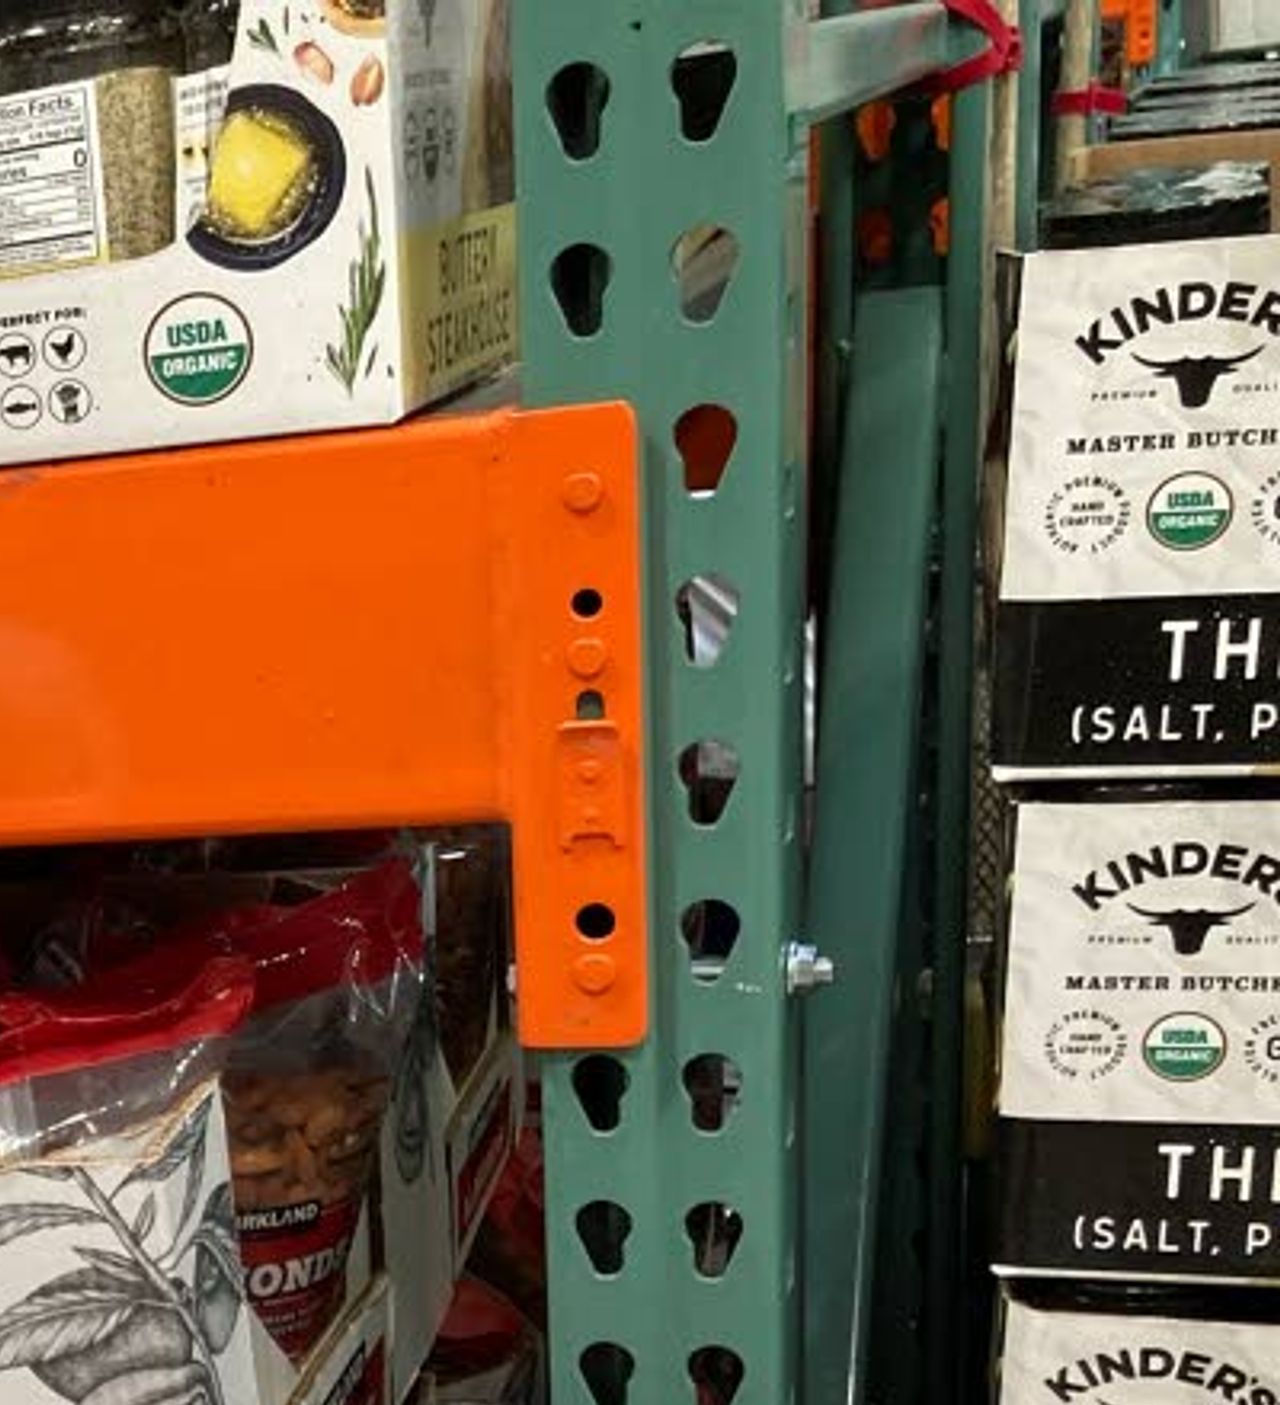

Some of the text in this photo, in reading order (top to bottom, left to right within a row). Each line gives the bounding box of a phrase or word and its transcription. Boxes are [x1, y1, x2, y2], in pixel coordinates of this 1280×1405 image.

[28, 95, 74, 116] Facts
[166, 318, 228, 347] USDA
[163, 350, 238, 378] ORGANIC
[1091, 389, 1158, 402] PREMIUM
[1065, 428, 1279, 455] MASTER BUTCH
[1167, 490, 1215, 509] USDA
[1157, 513, 1220, 530] ORGANIC
[1161, 618, 1280, 683] TH
[1070, 704, 1226, 744] (SALT,
[1065, 976, 1171, 991] MASTER
[1161, 1029, 1209, 1045] USDA
[1074, 1215, 1223, 1258] (SALT,
